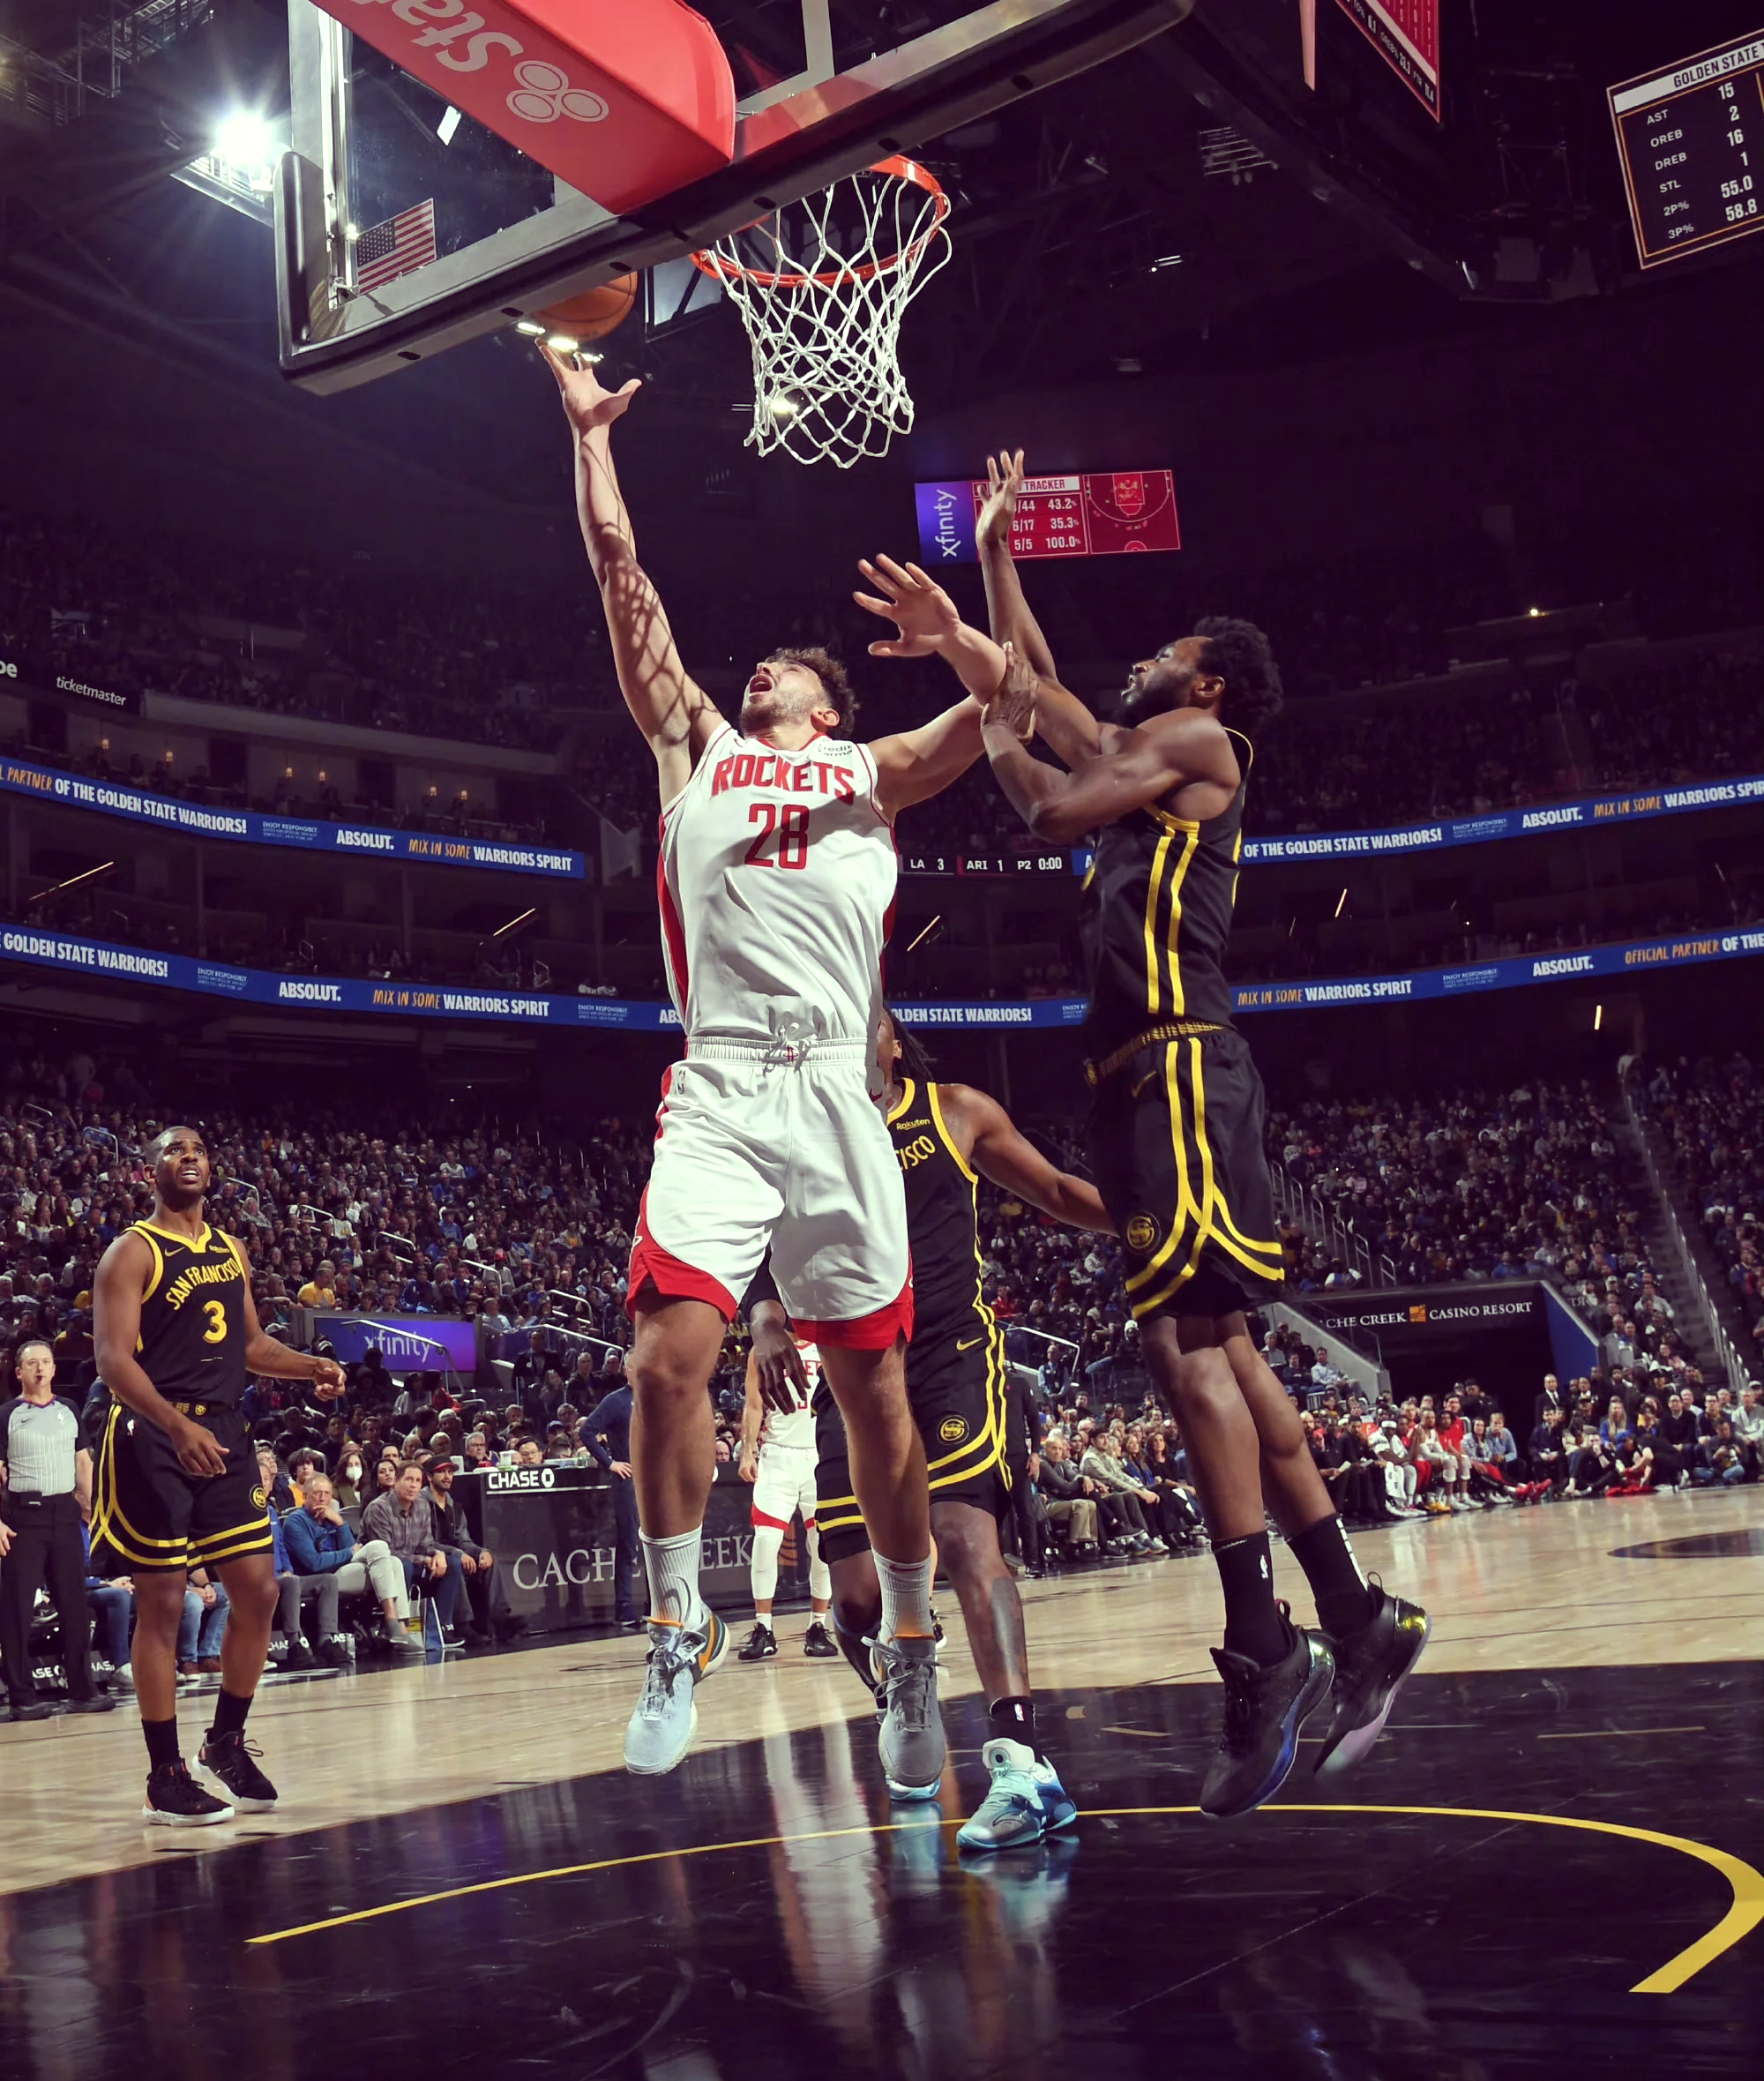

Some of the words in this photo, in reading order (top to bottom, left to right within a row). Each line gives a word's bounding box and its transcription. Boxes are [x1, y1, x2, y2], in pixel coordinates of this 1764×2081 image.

[353, 0, 524, 72] Sta
[1674, 60, 1720, 88] GOLDEN
[1722, 44, 1759, 71] STATE
[1647, 109, 1669, 125] AST
[1718, 82, 1735, 100] 15
[1650, 129, 1683, 148] OREB
[1729, 105, 1740, 122] 2
[1655, 152, 1687, 170] DREB
[1727, 128, 1744, 146] 16
[1660, 179, 1682, 193] STL
[1740, 151, 1748, 167] 1
[1663, 200, 1690, 217] 2P%
[1720, 175, 1753, 199] 55.0
[1668, 223, 1694, 239] 3P%
[1725, 198, 1758, 222] 58.8
[1024, 478, 1065, 491] TRACKER
[934, 489, 961, 558] xfinity
[1014, 539, 1033, 551] 5/5
[56, 676, 127, 706] ticketmaster
[711, 754, 855, 806] ROCKETS
[7, 767, 53, 791] PARTNER
[55, 778, 71, 795] OF
[72, 782, 95, 802] THE
[97, 786, 142, 813] GOLDEN
[143, 799, 177, 820] STATE
[178, 806, 247, 834] WARRIORS!
[1521, 806, 1583, 828] ABSOLUT.
[1594, 802, 1615, 818] MIX
[1618, 800, 1630, 813] IN
[1633, 796, 1662, 812] SOME
[1664, 784, 1737, 808] WARRIORS
[336, 829, 394, 850] ABSOLUT.
[744, 803, 810, 871] 28
[1244, 843, 1259, 857] OF
[1260, 842, 1284, 856] THE
[1286, 838, 1333, 855] GOLDEN
[1334, 836, 1370, 852] STATE
[1371, 827, 1443, 850] WARRIORS!
[408, 839, 428, 855] MIX
[430, 841, 442, 856] IN
[444, 842, 470, 860] SOME
[473, 845, 535, 867] WARRIORS
[536, 854, 572, 872] SPIRIT
[910, 858, 925, 869] LA
[937, 858, 945, 871] 3
[966, 860, 988, 870] ARI
[998, 859, 1004, 872] 1
[1017, 860, 1032, 870] P2
[1038, 857, 1063, 871] 0:00
[4, 932, 56, 958] GOLDEN
[57, 942, 95, 965] STATE
[97, 949, 168, 977] WARRIORS!
[1625, 946, 1669, 965] OFFICIAL
[1672, 939, 1719, 958] PARTNER
[1722, 937, 1738, 952] OF
[1740, 932, 1764, 949] THE
[1532, 955, 1594, 977] ABSOLUT.
[278, 981, 341, 1002] ABSOLUT.
[373, 989, 394, 1005] MIX
[397, 991, 409, 1007] IN
[411, 992, 440, 1008] SOME
[443, 993, 510, 1014] WARRIORS
[511, 999, 549, 1017] SPIRIT
[1237, 991, 1258, 1007] MIX
[1260, 990, 1272, 1004] IN
[1274, 988, 1303, 1003] SOME
[1304, 983, 1372, 1002] WARRIORS
[1372, 979, 1412, 997] SPIRIT
[930, 1008, 963, 1022] STATE
[965, 1007, 1032, 1022] WARRIORS!
[896, 1119, 931, 1131] Rakuten
[165, 1275, 193, 1311] SAN
[184, 1257, 242, 1287] FRANCISCO
[201, 1299, 228, 1344] 3
[1359, 1312, 1407, 1327] CREEK
[1429, 1306, 1480, 1321] CASINO
[1483, 1301, 1533, 1316] RESORT
[488, 1471, 540, 1489] CHASE
